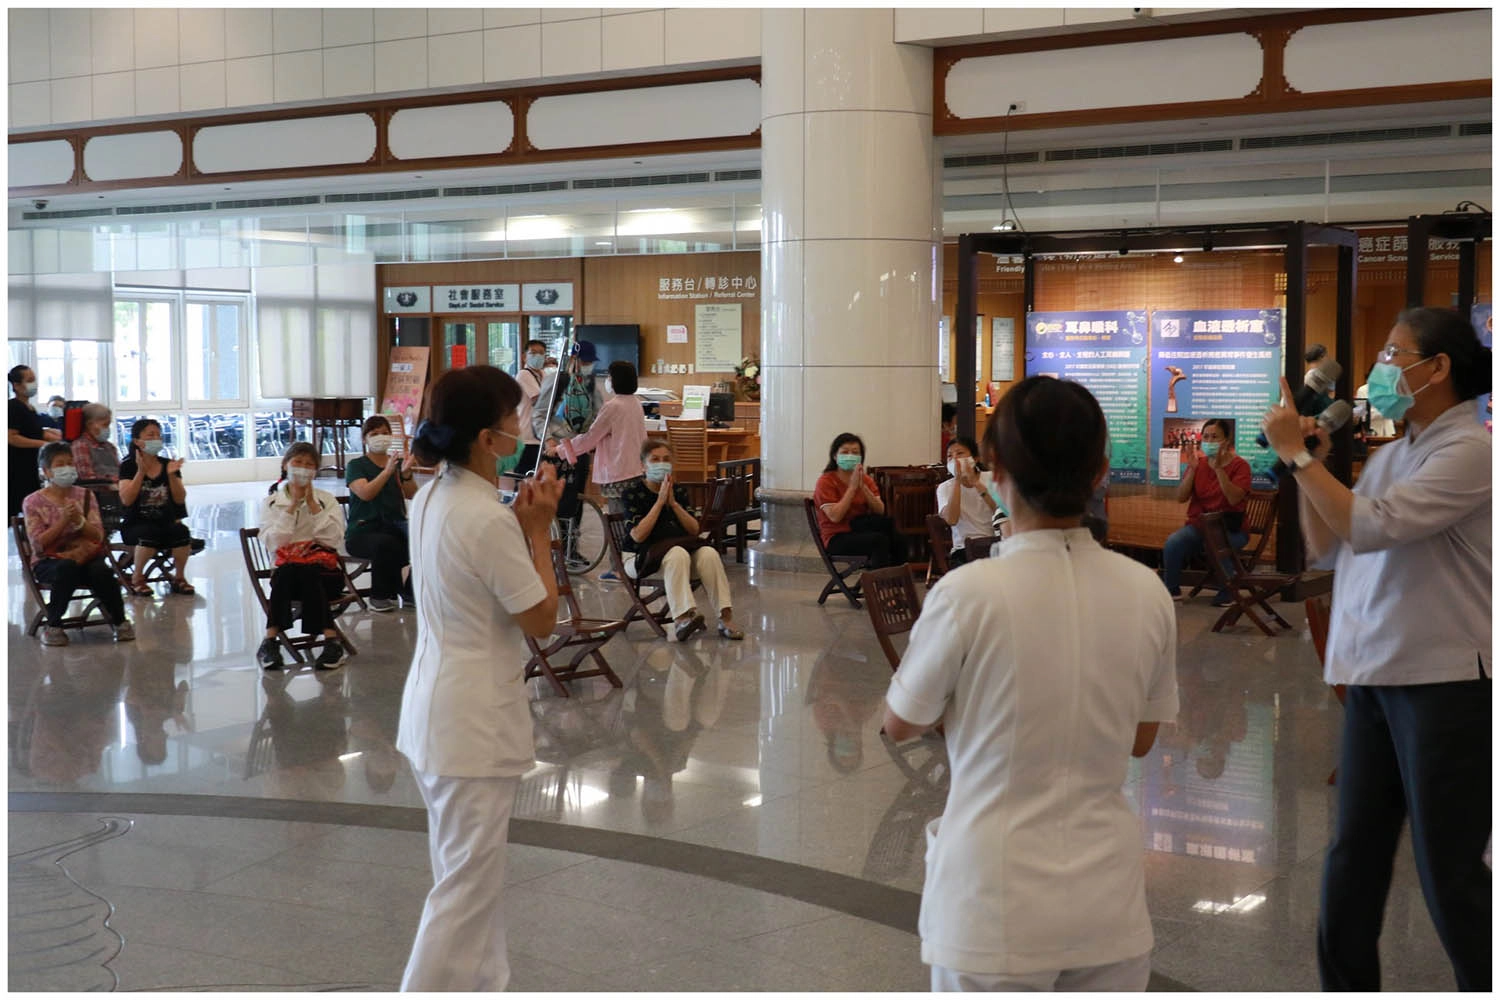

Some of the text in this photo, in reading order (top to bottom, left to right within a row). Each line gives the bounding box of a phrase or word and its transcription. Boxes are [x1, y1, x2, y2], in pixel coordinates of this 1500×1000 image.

[658, 276, 757, 291] 服務台/轉診中心
[448, 288, 504, 300] 社會服務室
